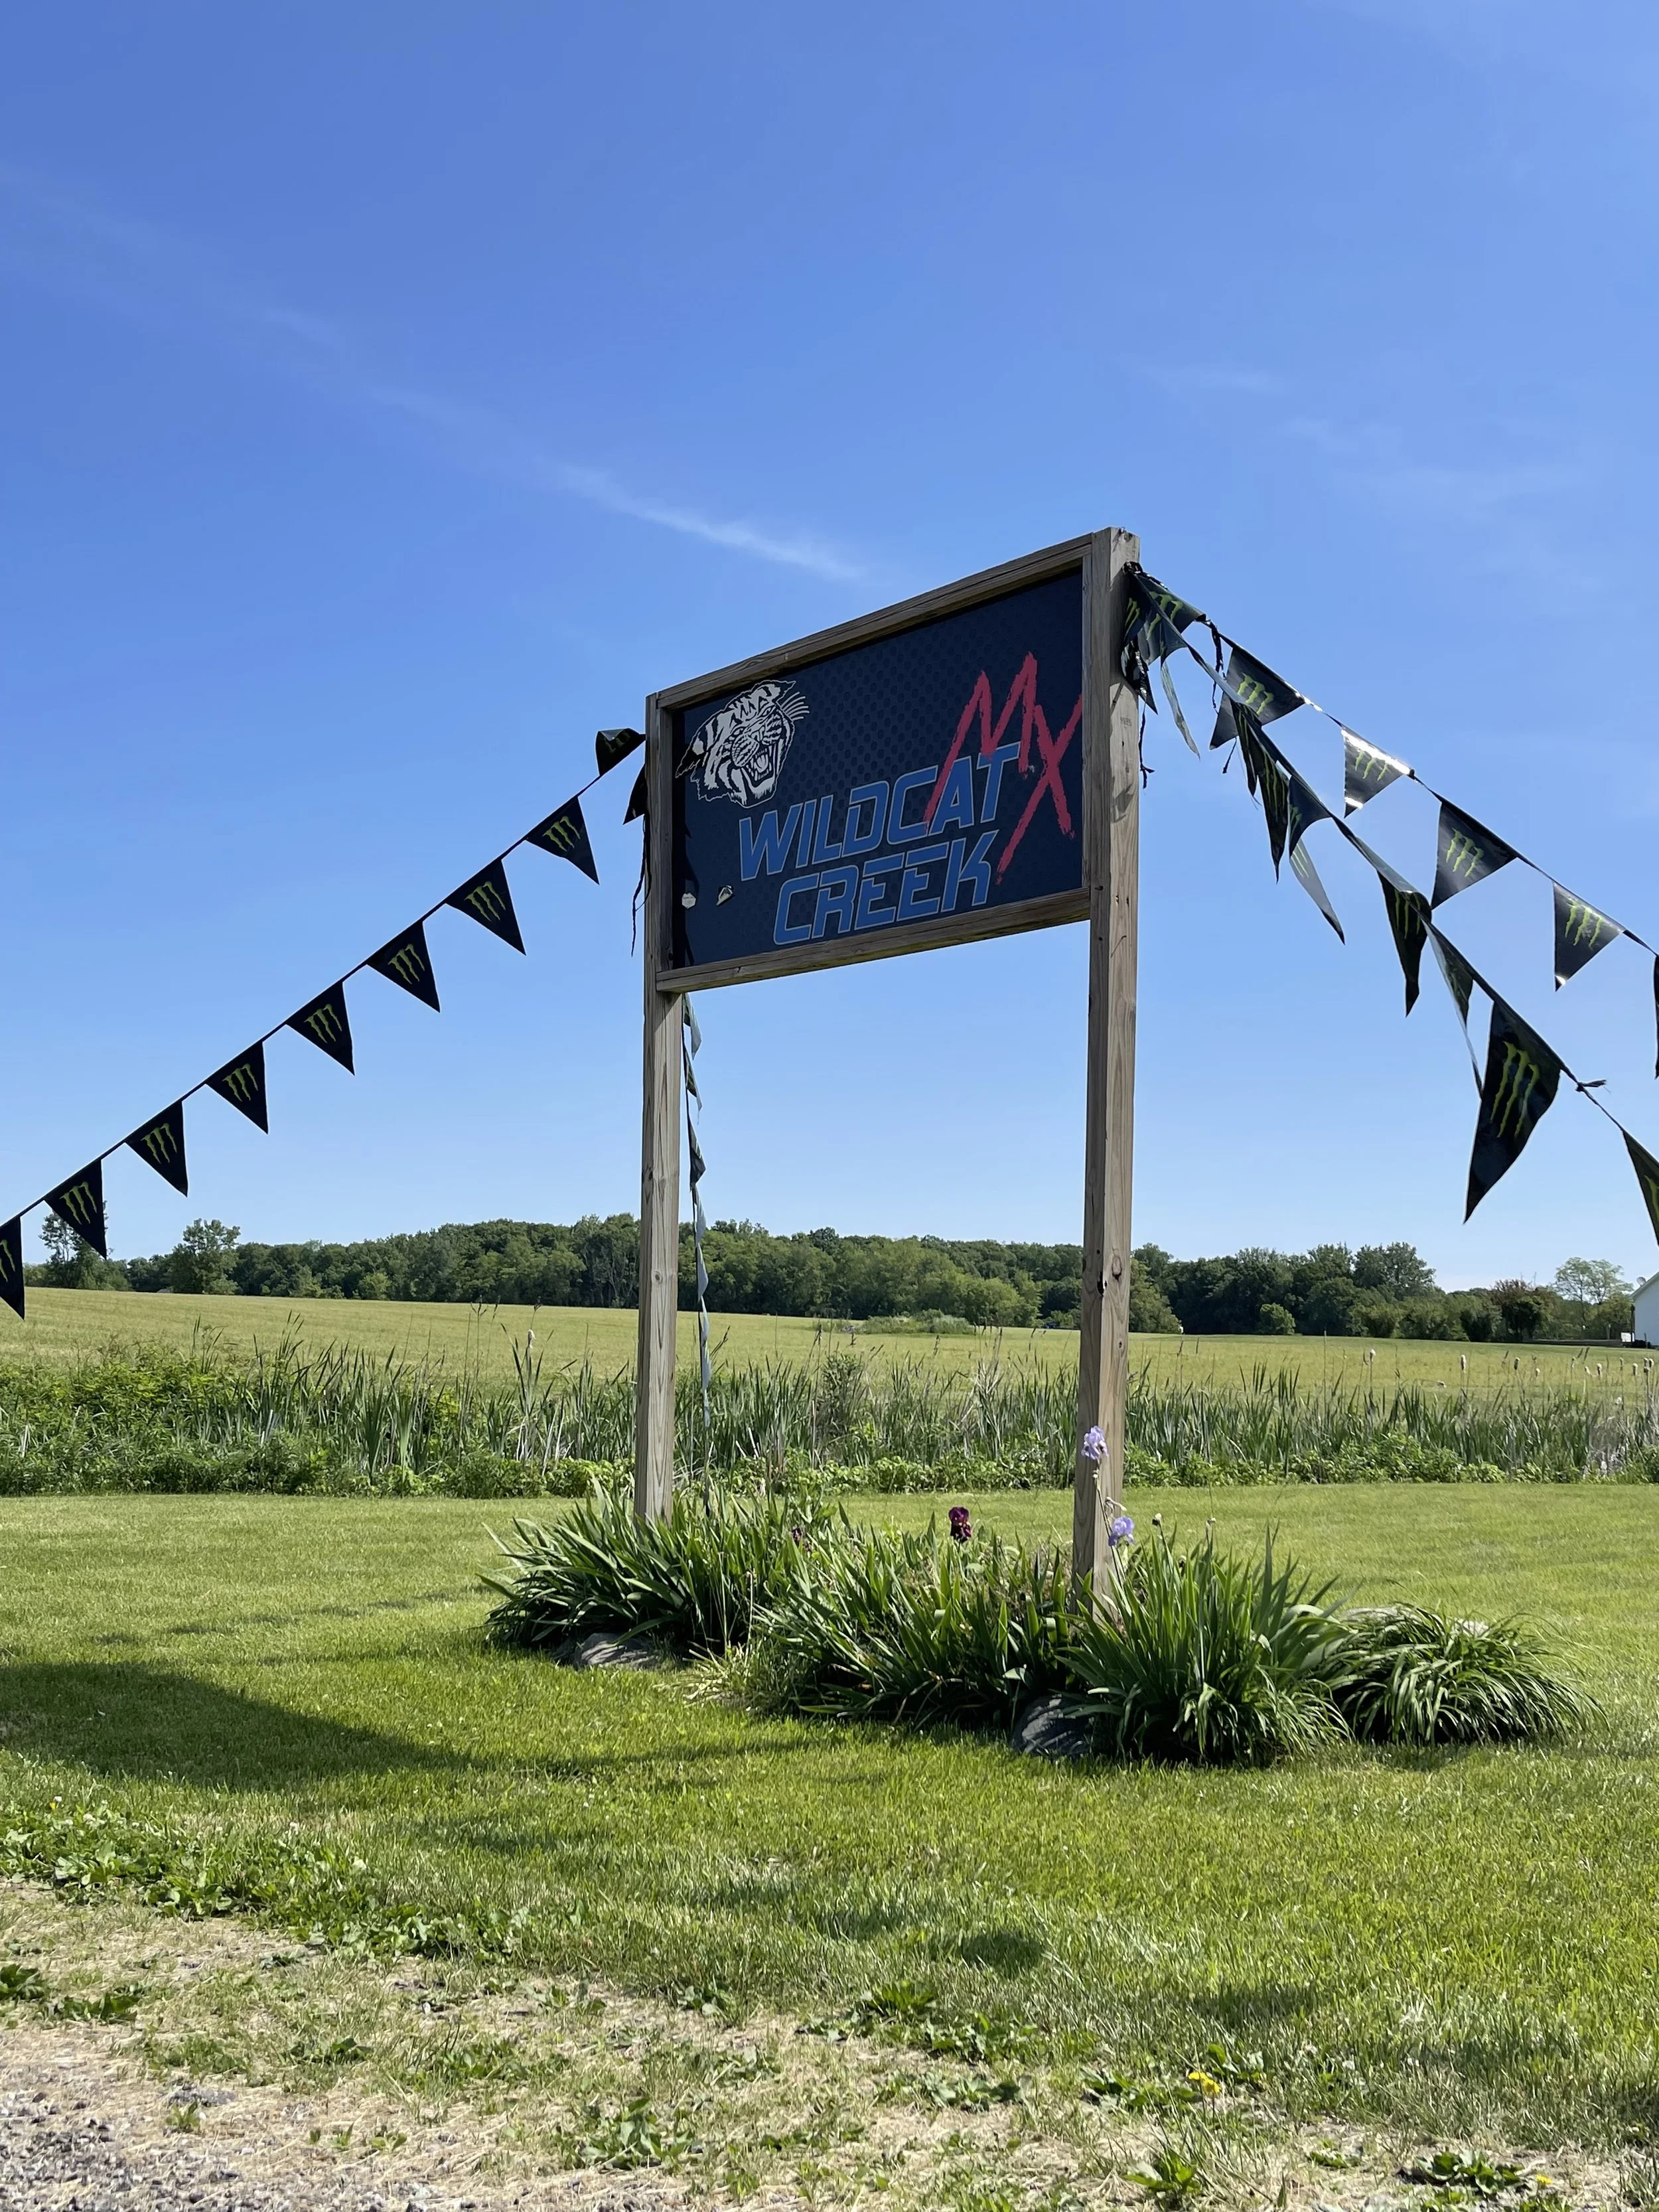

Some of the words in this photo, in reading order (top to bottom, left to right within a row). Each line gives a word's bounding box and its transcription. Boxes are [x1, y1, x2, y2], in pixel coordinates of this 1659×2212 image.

[739, 741, 1021, 881] WILDCAT
[923, 651, 1082, 885] MX
[773, 829, 999, 945] CREEK
